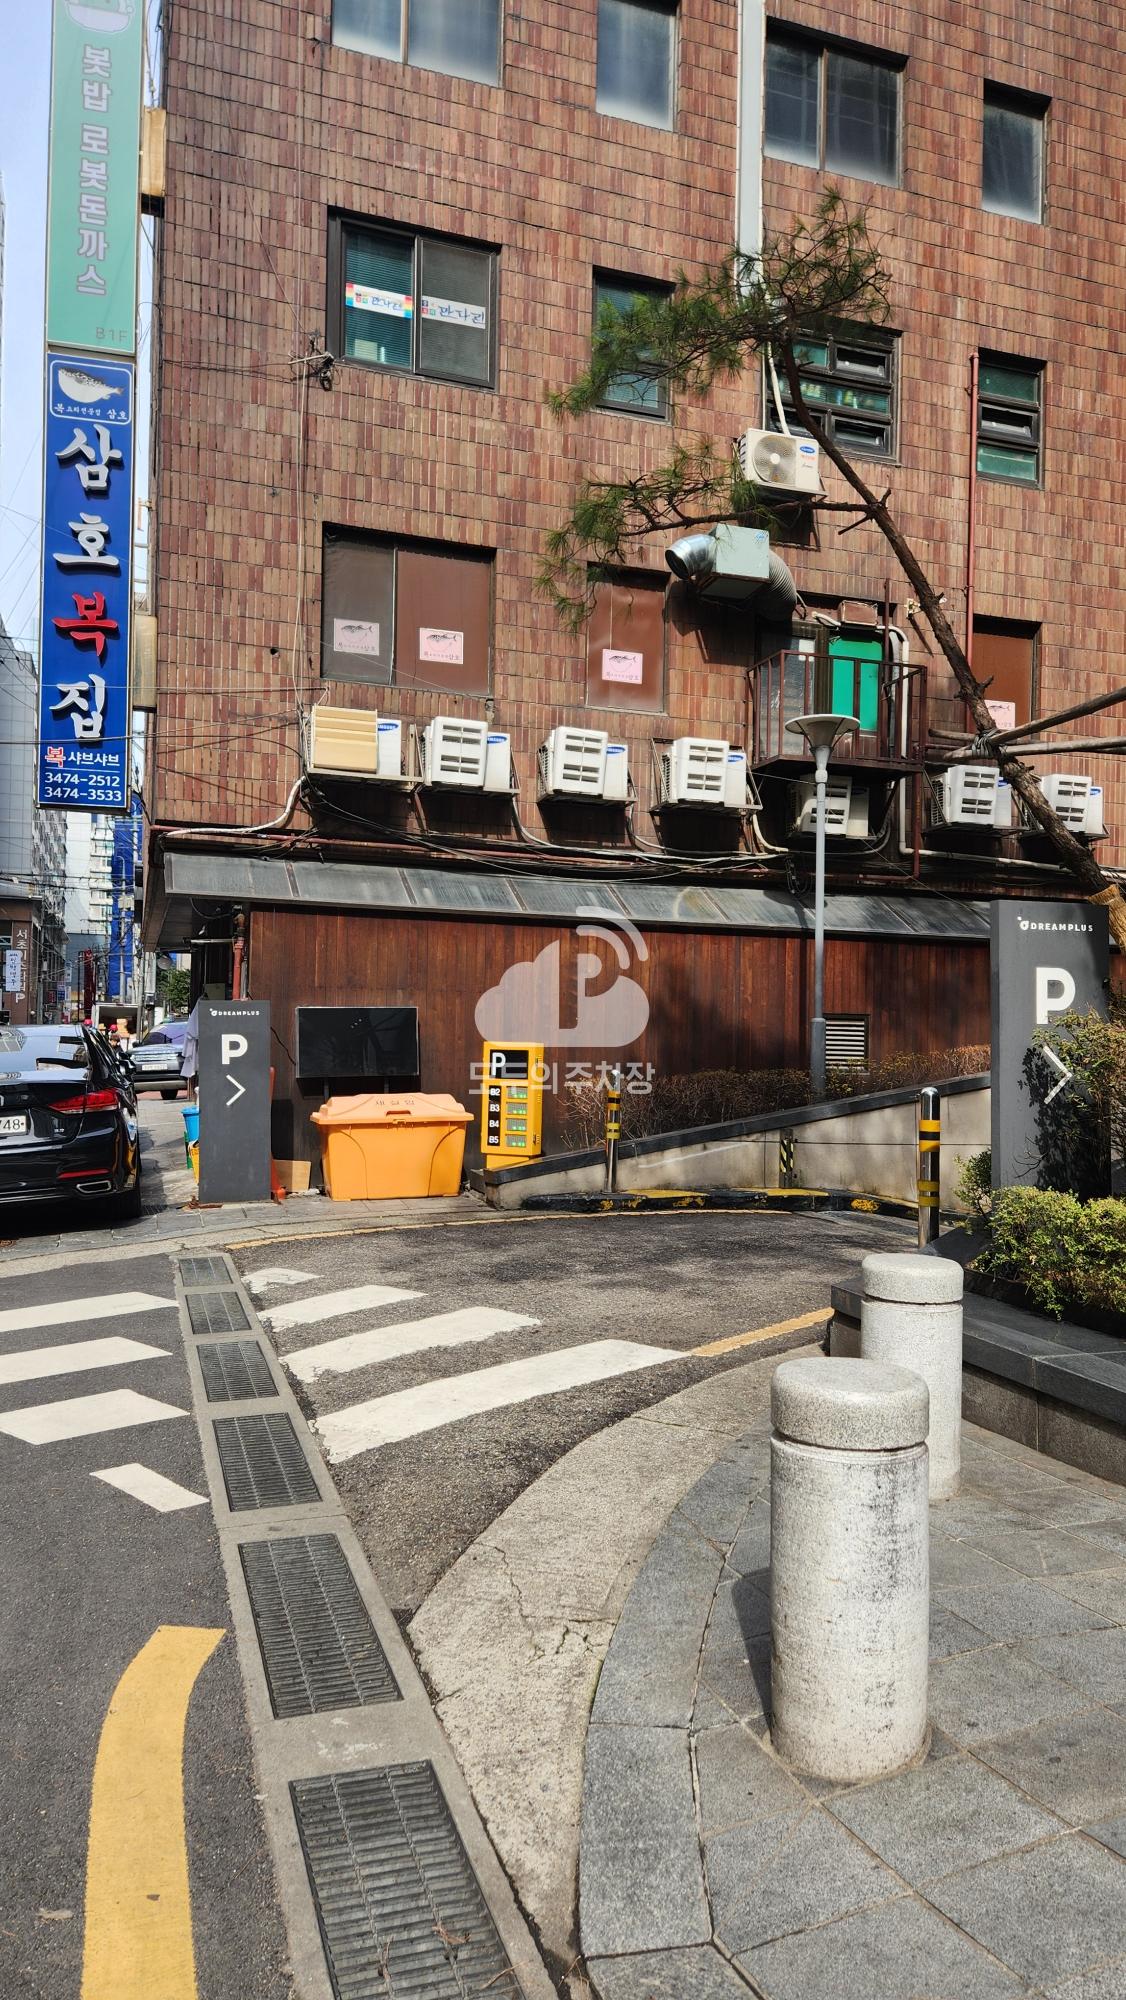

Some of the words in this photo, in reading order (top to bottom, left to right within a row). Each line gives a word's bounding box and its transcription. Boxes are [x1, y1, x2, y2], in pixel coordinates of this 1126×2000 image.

[82, 44, 112, 112] 봇밥
[76, 123, 110, 296] 로봇돈까스
[95, 327, 128, 343] B1F
[106, 409, 128, 420] 삼호
[49, 423, 122, 739] 삼호복집
[45, 746, 66, 768] 복
[68, 751, 120, 766] 샤브샤브
[44, 772, 120, 787] 3474-2512
[44, 786, 122, 802] 3474-3533
[1030, 922, 1094, 932] DREAMPLUS
[1036, 967, 1076, 1025] P
[221, 1033, 248, 1065] P
[491, 1052, 507, 1076] P
[490, 1087, 501, 1096] B2
[490, 1103, 500, 1112] B3
[489, 1119, 500, 1128] B4
[488, 1135, 499, 1144] B5
